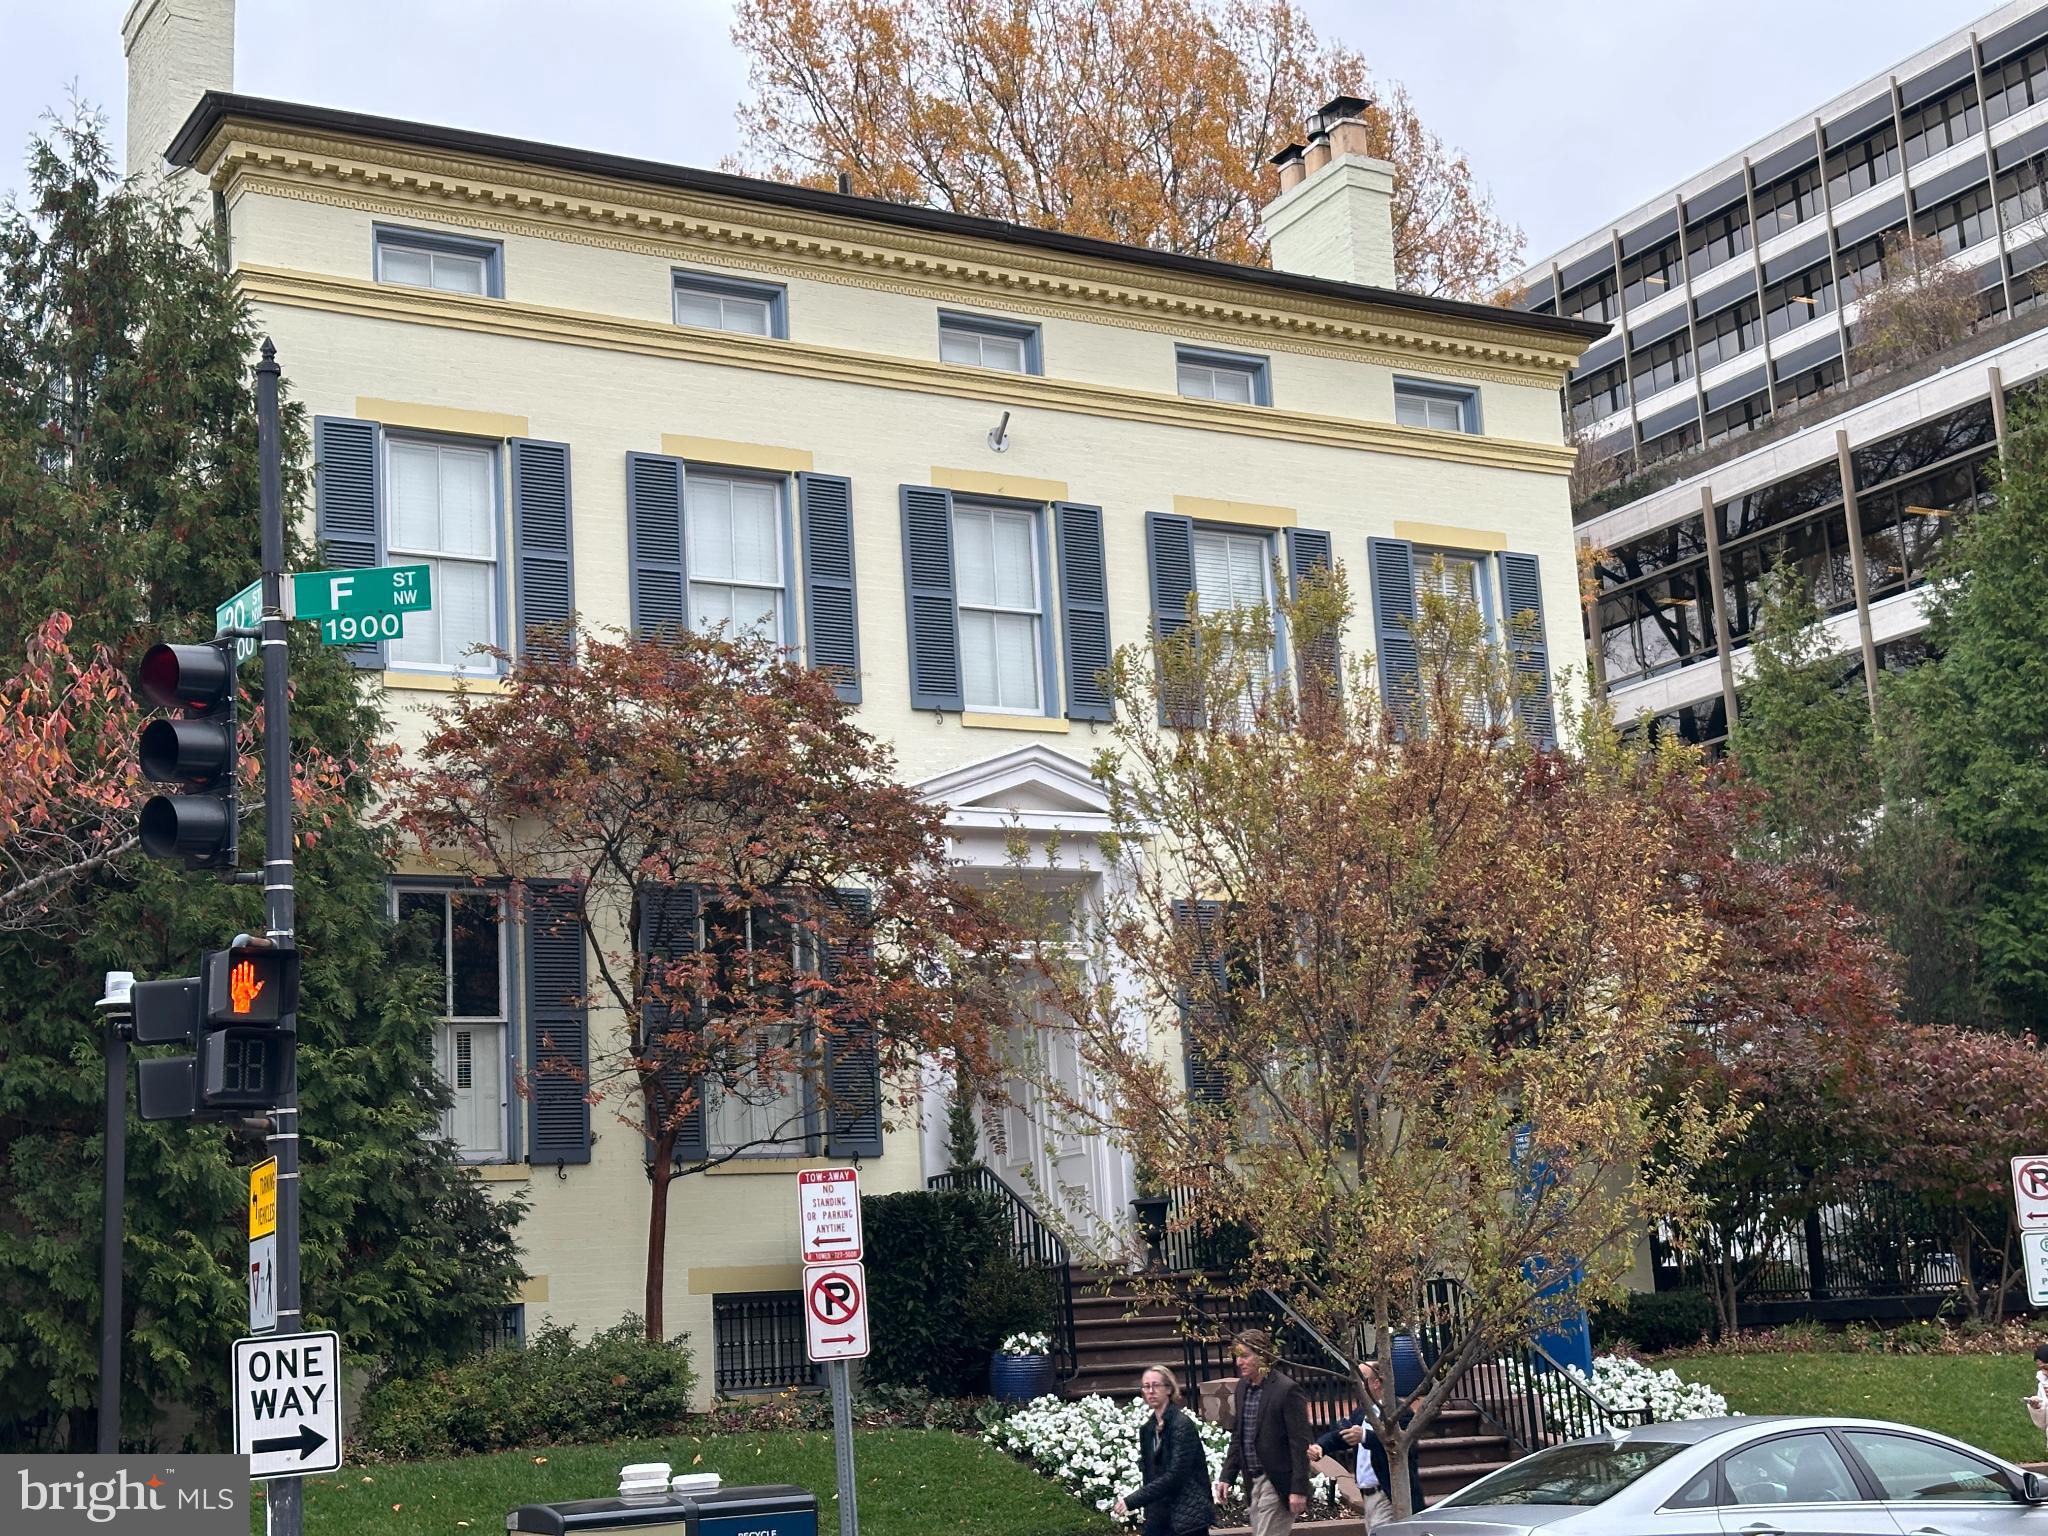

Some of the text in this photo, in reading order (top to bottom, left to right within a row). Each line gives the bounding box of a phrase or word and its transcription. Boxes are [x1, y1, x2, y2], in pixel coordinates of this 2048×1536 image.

[330, 572, 416, 611] F ST
[394, 590, 418, 605] NW
[225, 599, 245, 628] 20
[326, 613, 399, 641] 1900
[237, 638, 254, 660] 00
[805, 1171, 850, 1183] TOW-AWAY
[822, 1184, 834, 1194] NO
[812, 1197, 846, 1208] STANDING
[807, 1209, 853, 1221] OR PARKING
[816, 1223, 846, 1234] ANYTIME
[249, 1346, 323, 1383] ONE
[251, 1384, 327, 1421] WAY
